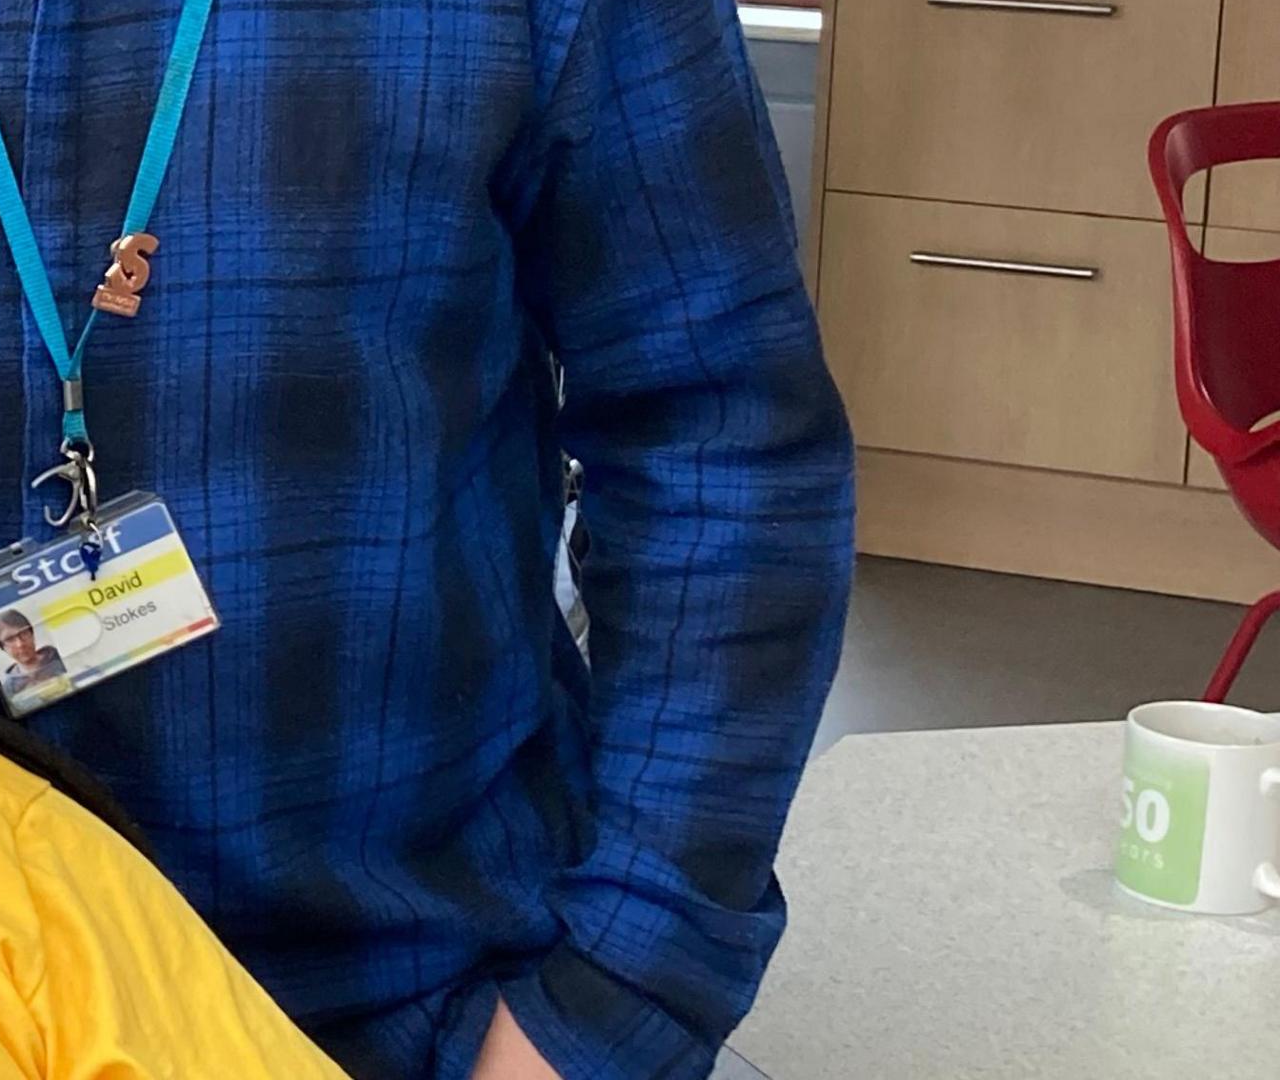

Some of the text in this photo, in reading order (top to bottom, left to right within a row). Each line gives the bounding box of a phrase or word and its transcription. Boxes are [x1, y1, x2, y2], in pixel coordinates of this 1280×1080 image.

[11, 525, 122, 596] Staf
[87, 570, 143, 607] David
[100, 601, 158, 632] Stokes
